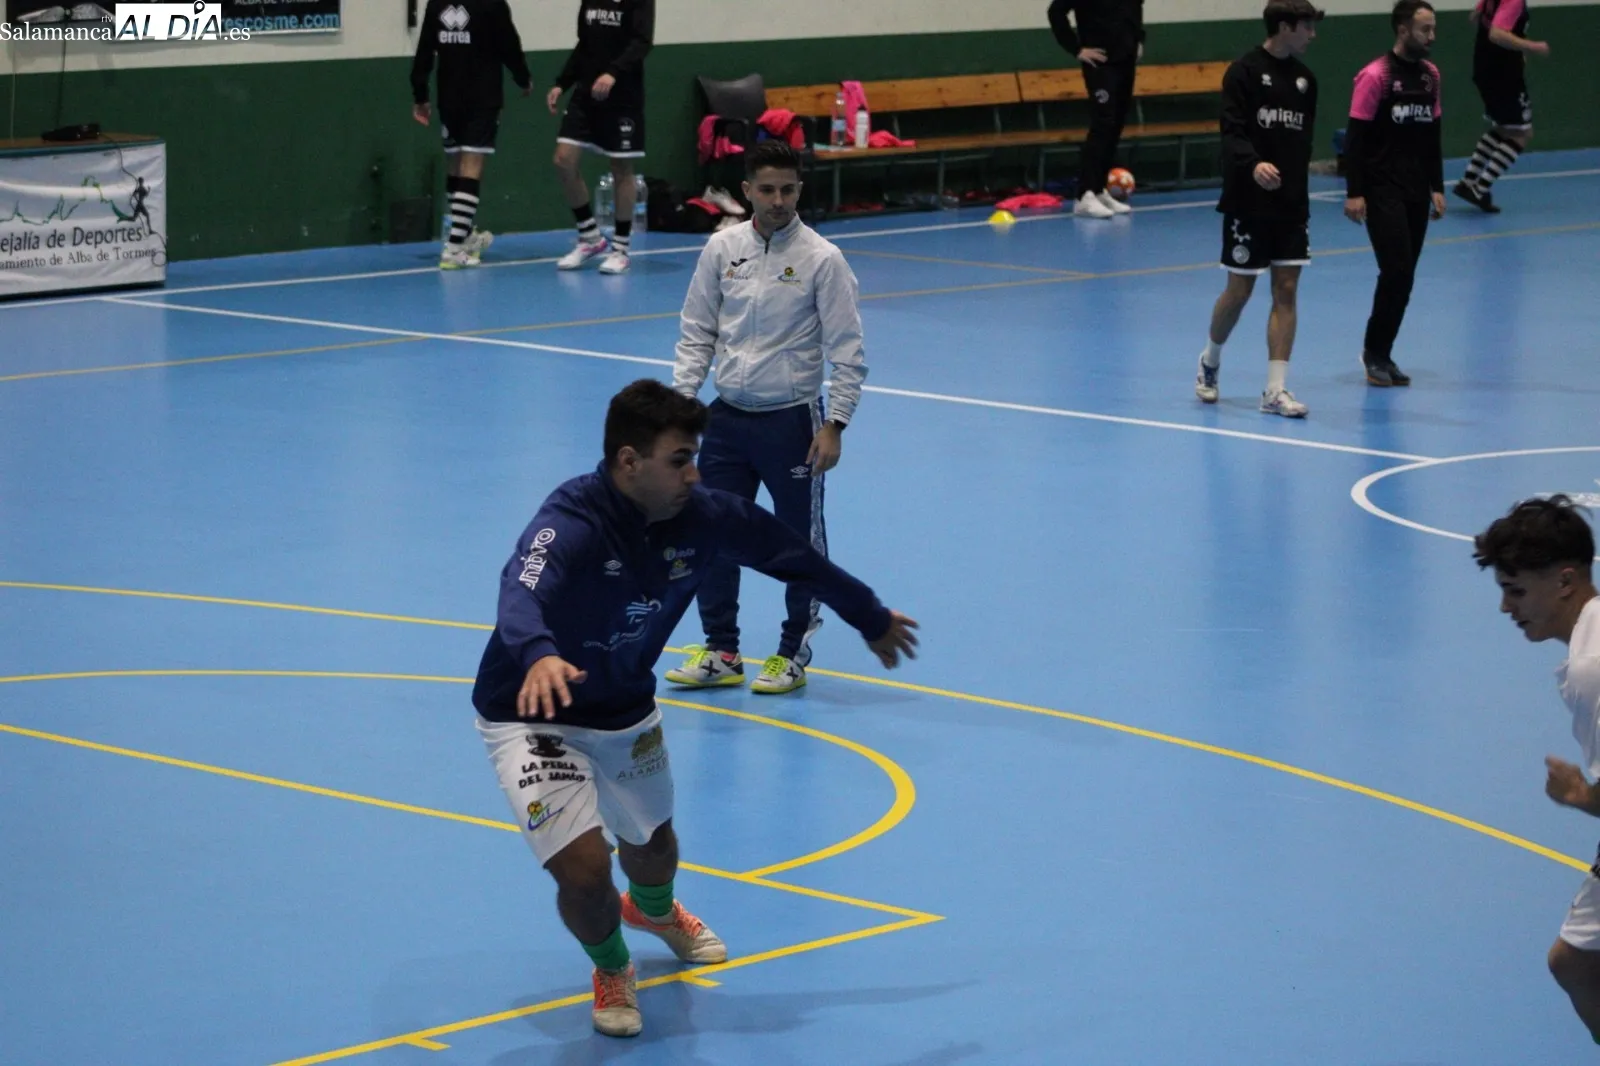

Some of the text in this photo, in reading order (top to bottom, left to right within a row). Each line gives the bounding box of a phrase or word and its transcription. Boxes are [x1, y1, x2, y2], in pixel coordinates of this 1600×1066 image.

[47, 229, 66, 248] de
[72, 226, 143, 248] Deportes
[50, 254, 63, 266] de
[67, 252, 93, 264] Alba
[97, 249, 110, 261] de
[113, 246, 156, 260] Tormes
[522, 762, 539, 774] LA
[518, 774, 543, 788] DEL
